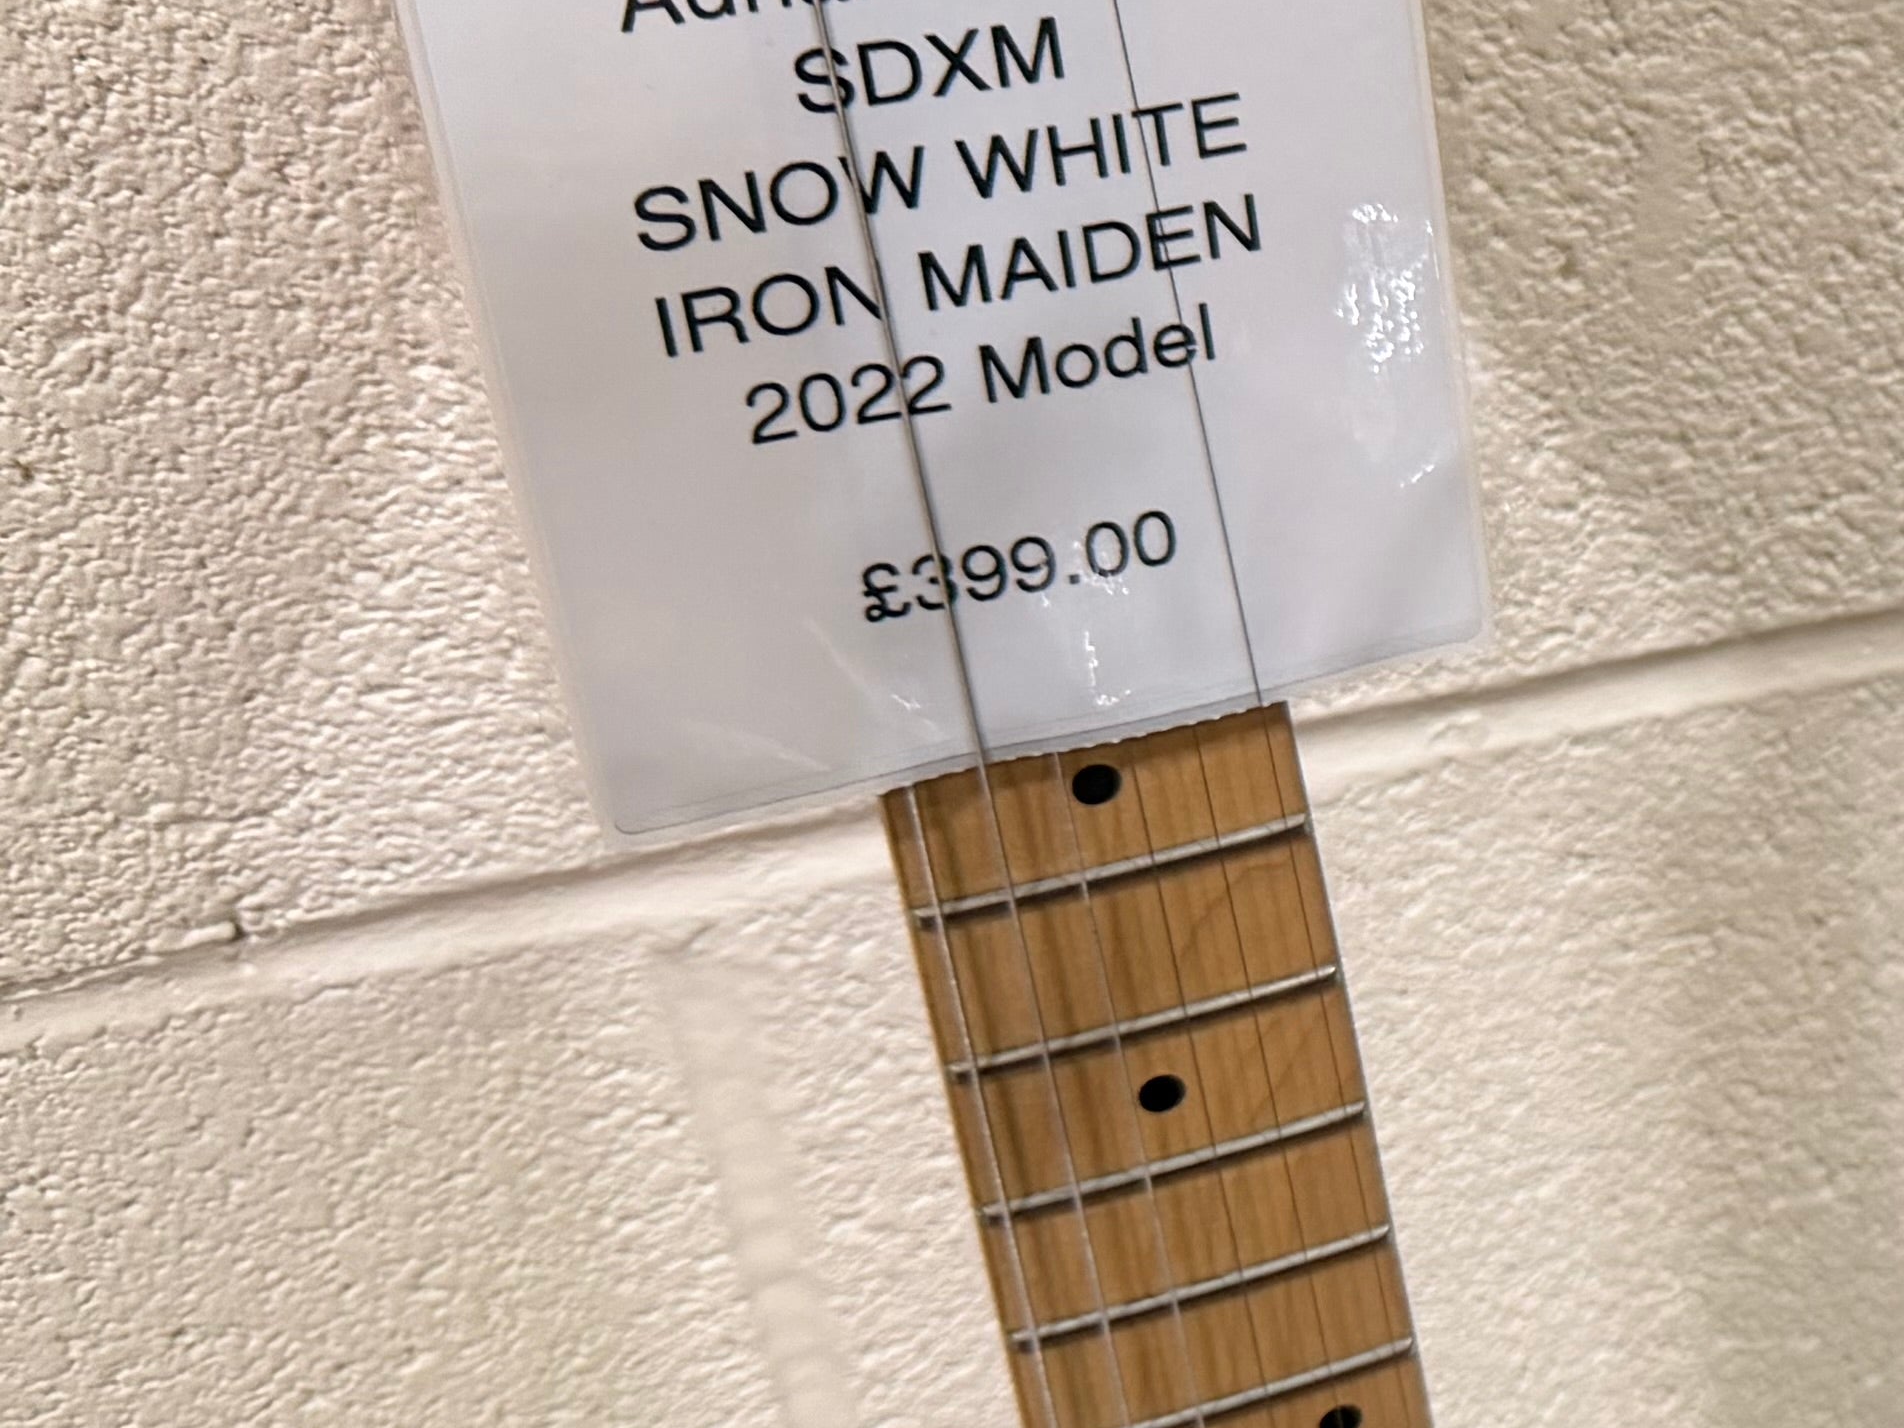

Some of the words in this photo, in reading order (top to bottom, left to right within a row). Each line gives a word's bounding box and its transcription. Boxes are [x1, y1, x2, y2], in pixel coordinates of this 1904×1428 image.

[793, 15, 1066, 114] SDXM
[633, 144, 925, 252] SNOW
[954, 91, 1249, 200] WHITE
[654, 264, 888, 359] IRON
[916, 192, 1263, 312] MAIDEN
[744, 353, 952, 445] 2022
[978, 301, 1217, 404] Model
[860, 509, 1178, 624] £399.00
